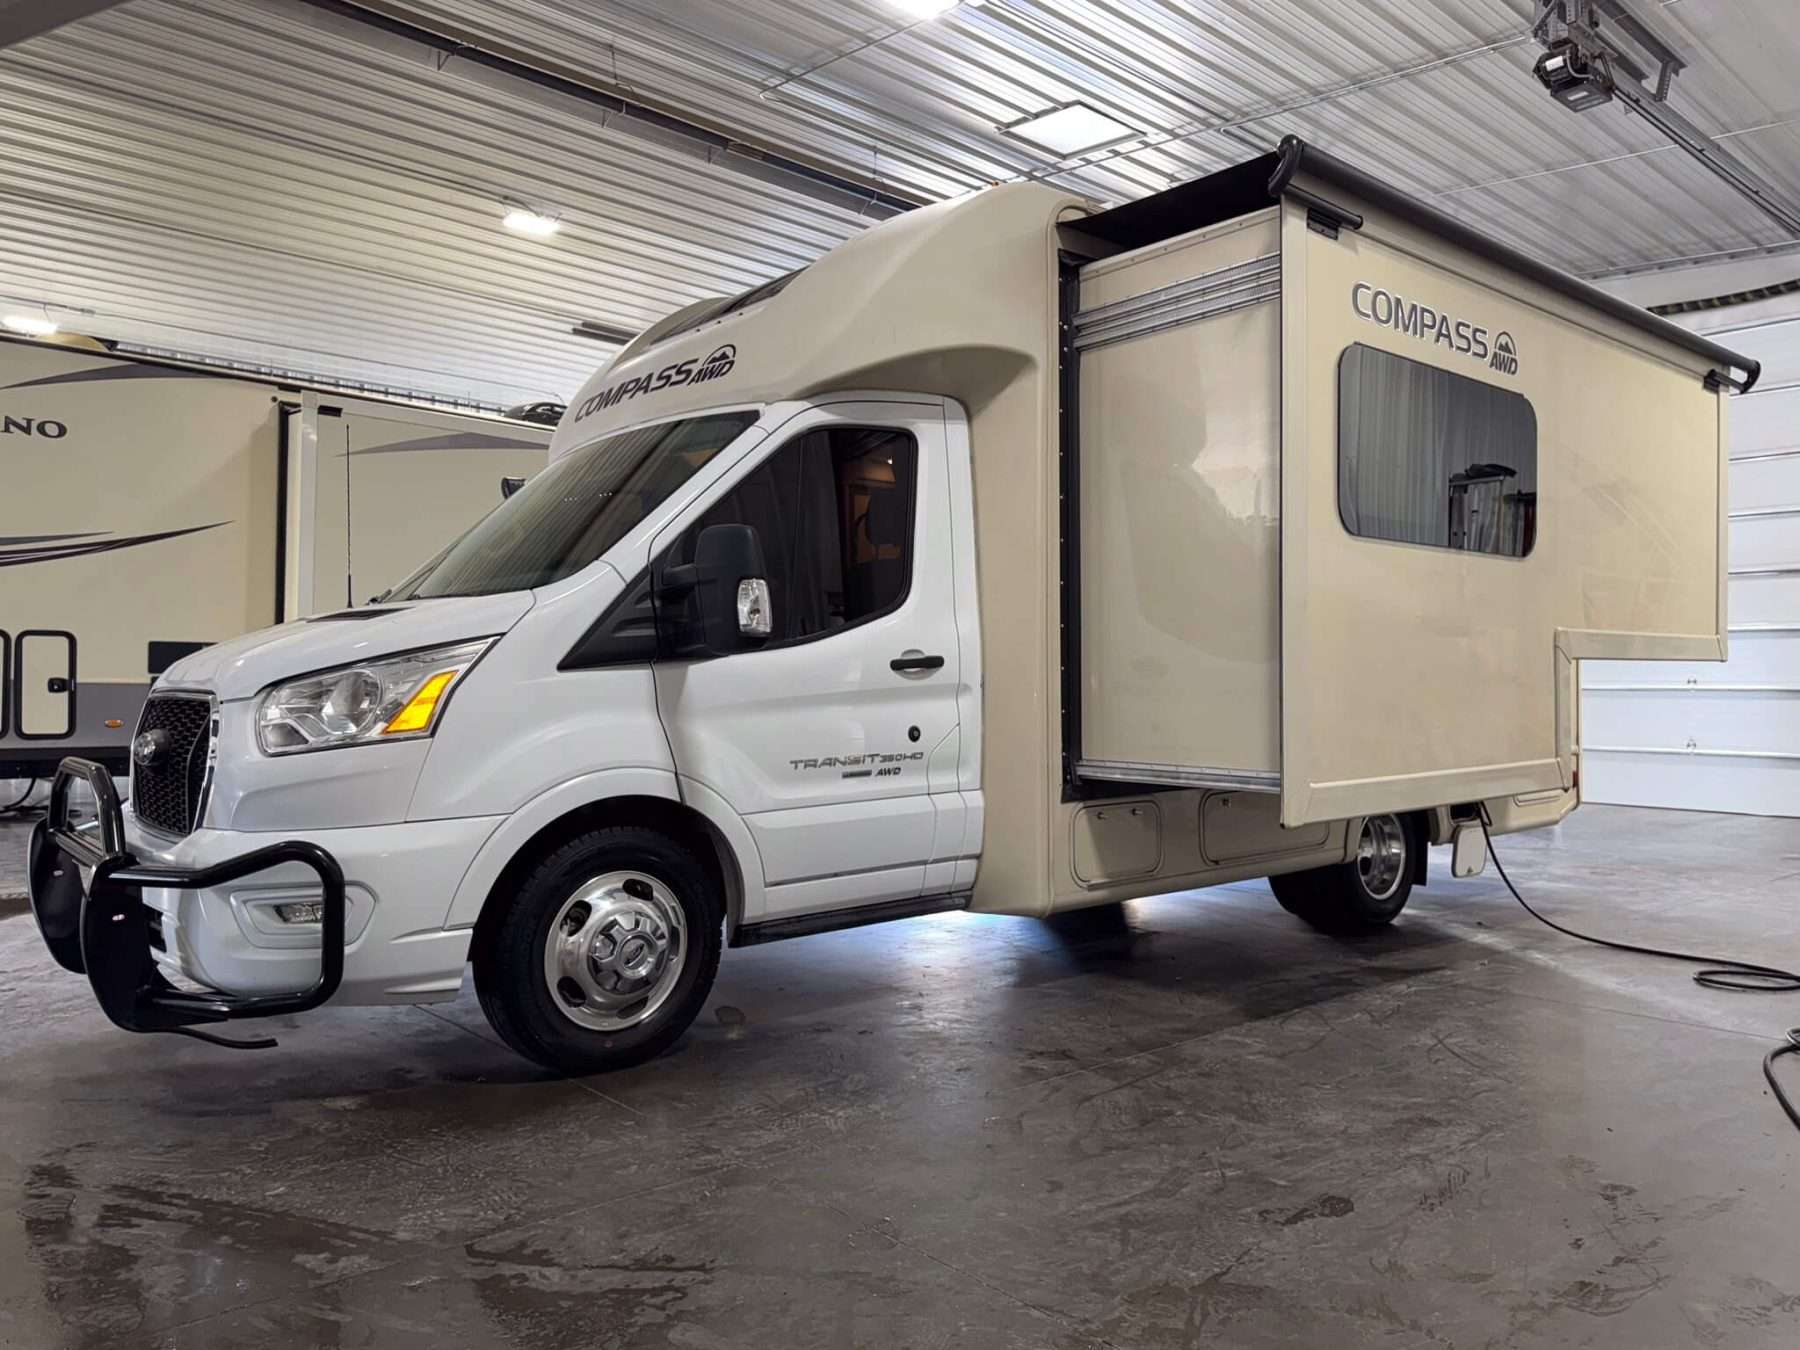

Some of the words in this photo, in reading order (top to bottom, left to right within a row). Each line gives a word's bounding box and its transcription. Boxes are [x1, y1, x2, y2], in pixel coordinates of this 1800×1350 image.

[1352, 283, 1489, 359] COMPASS
[1490, 354, 1518, 376] AWD
[574, 358, 699, 423] COMPASS
[687, 359, 735, 386] AWD
[790, 753, 880, 770] TRANSIT
[875, 767, 901, 777] AWD
